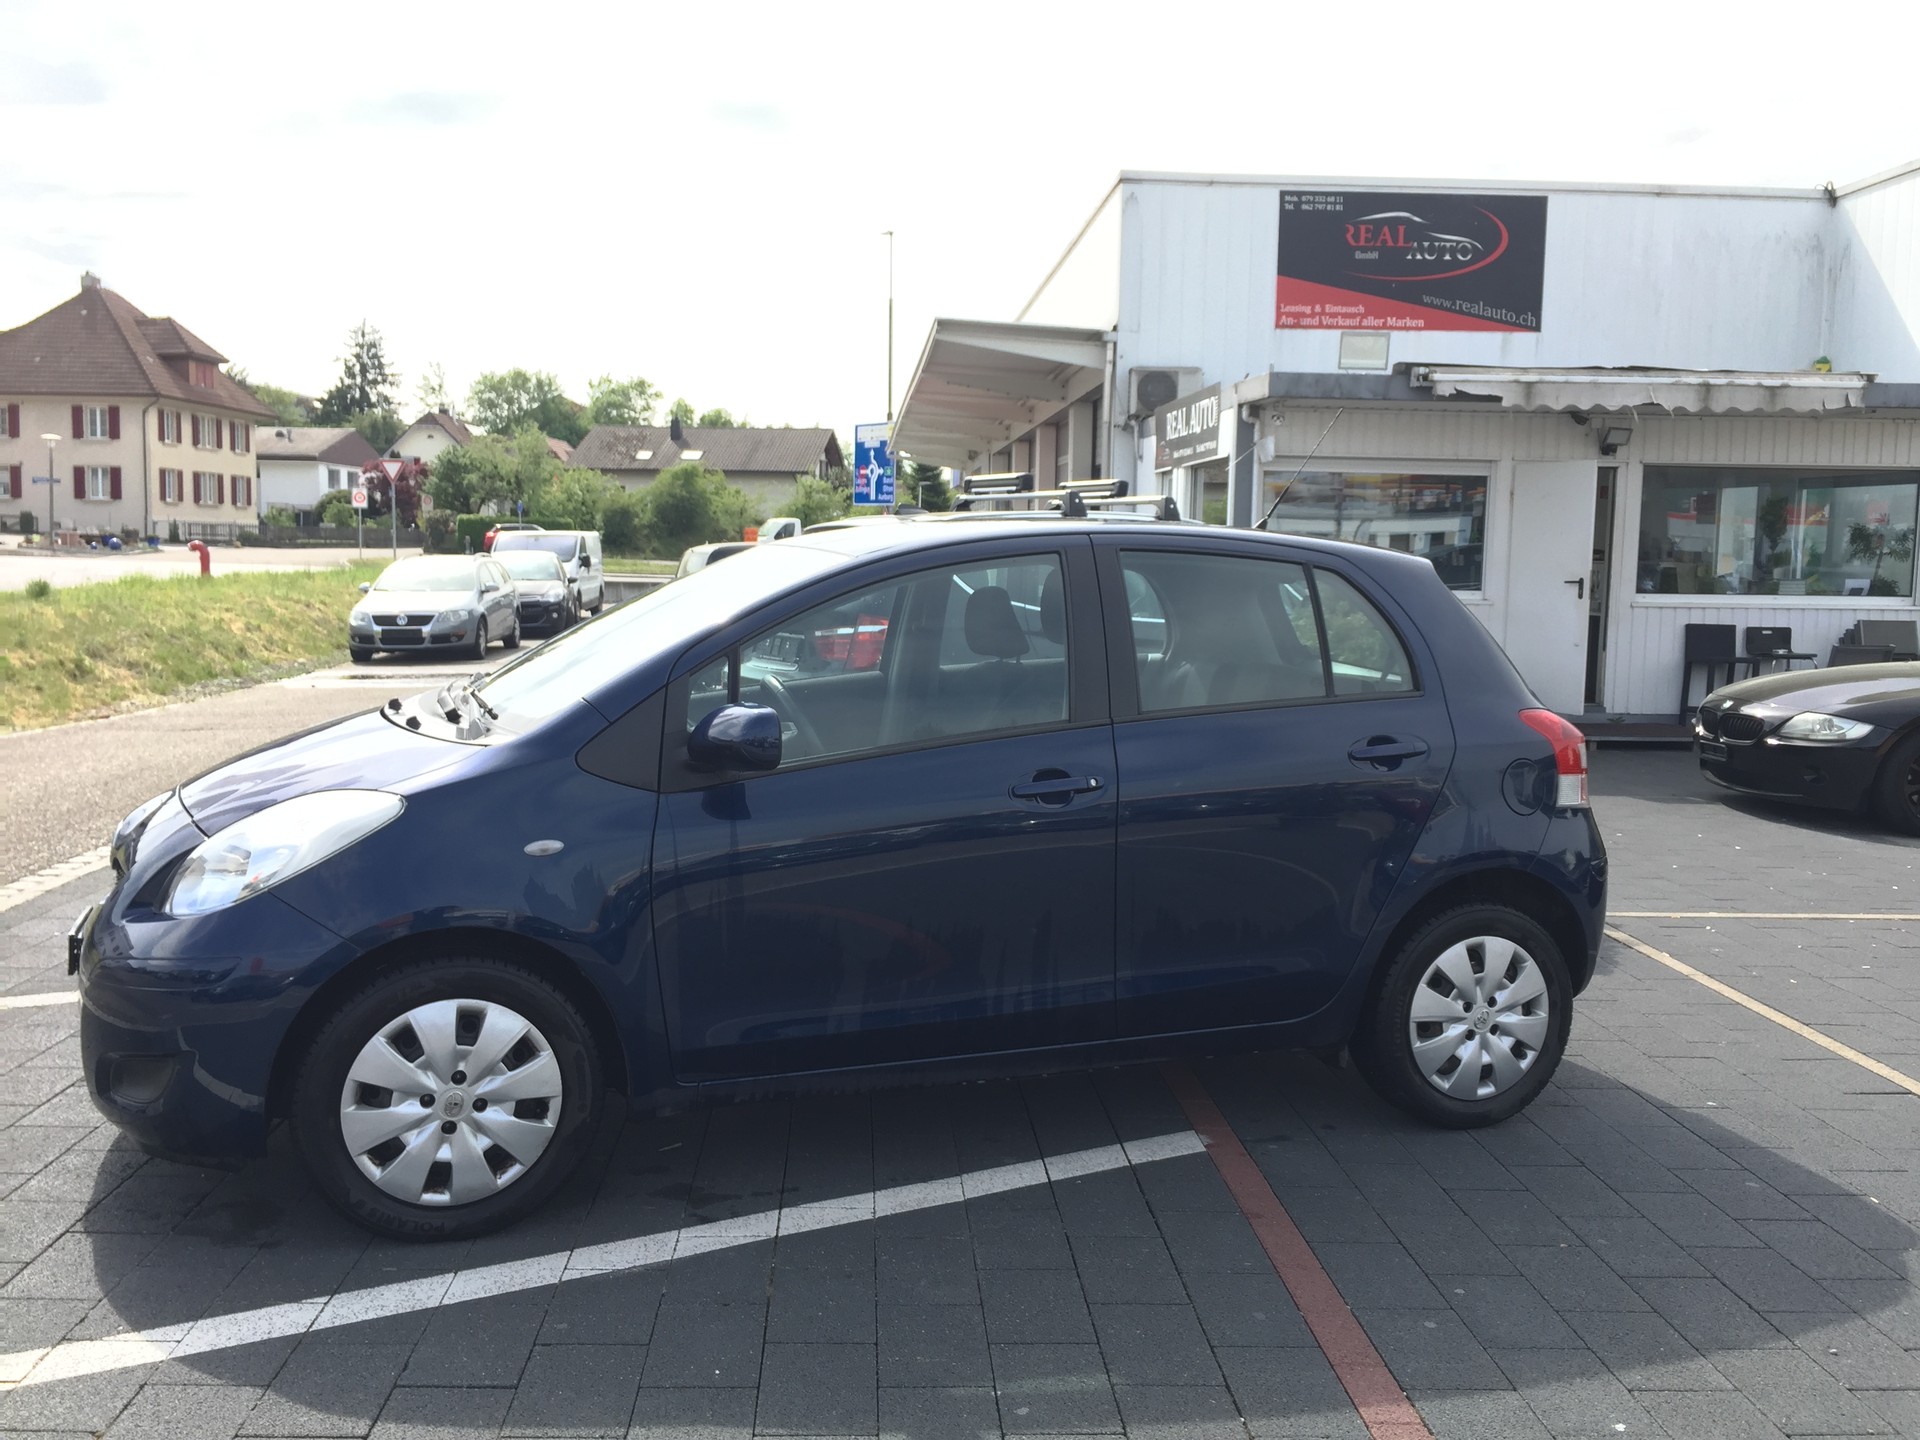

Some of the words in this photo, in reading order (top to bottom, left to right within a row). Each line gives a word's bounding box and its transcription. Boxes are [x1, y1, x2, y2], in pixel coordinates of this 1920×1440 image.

[1345, 223, 1413, 247] REAL
[1355, 250, 1379, 260] GmbH
[1405, 241, 1473, 261] AUTO
[1280, 304, 1312, 314] Leasing
[1314, 304, 1322, 313] &
[1325, 304, 1365, 313] Eintausch
[1422, 294, 1537, 327] www.realauto.ch
[1280, 315, 1298, 326] An-
[1300, 316, 1319, 326] und
[1321, 316, 1361, 326] Verkauf
[1362, 317, 1385, 327] aller
[1387, 317, 1425, 327] Marken
[1166, 407, 1188, 441] REAL
[1189, 396, 1216, 434] AUTO
